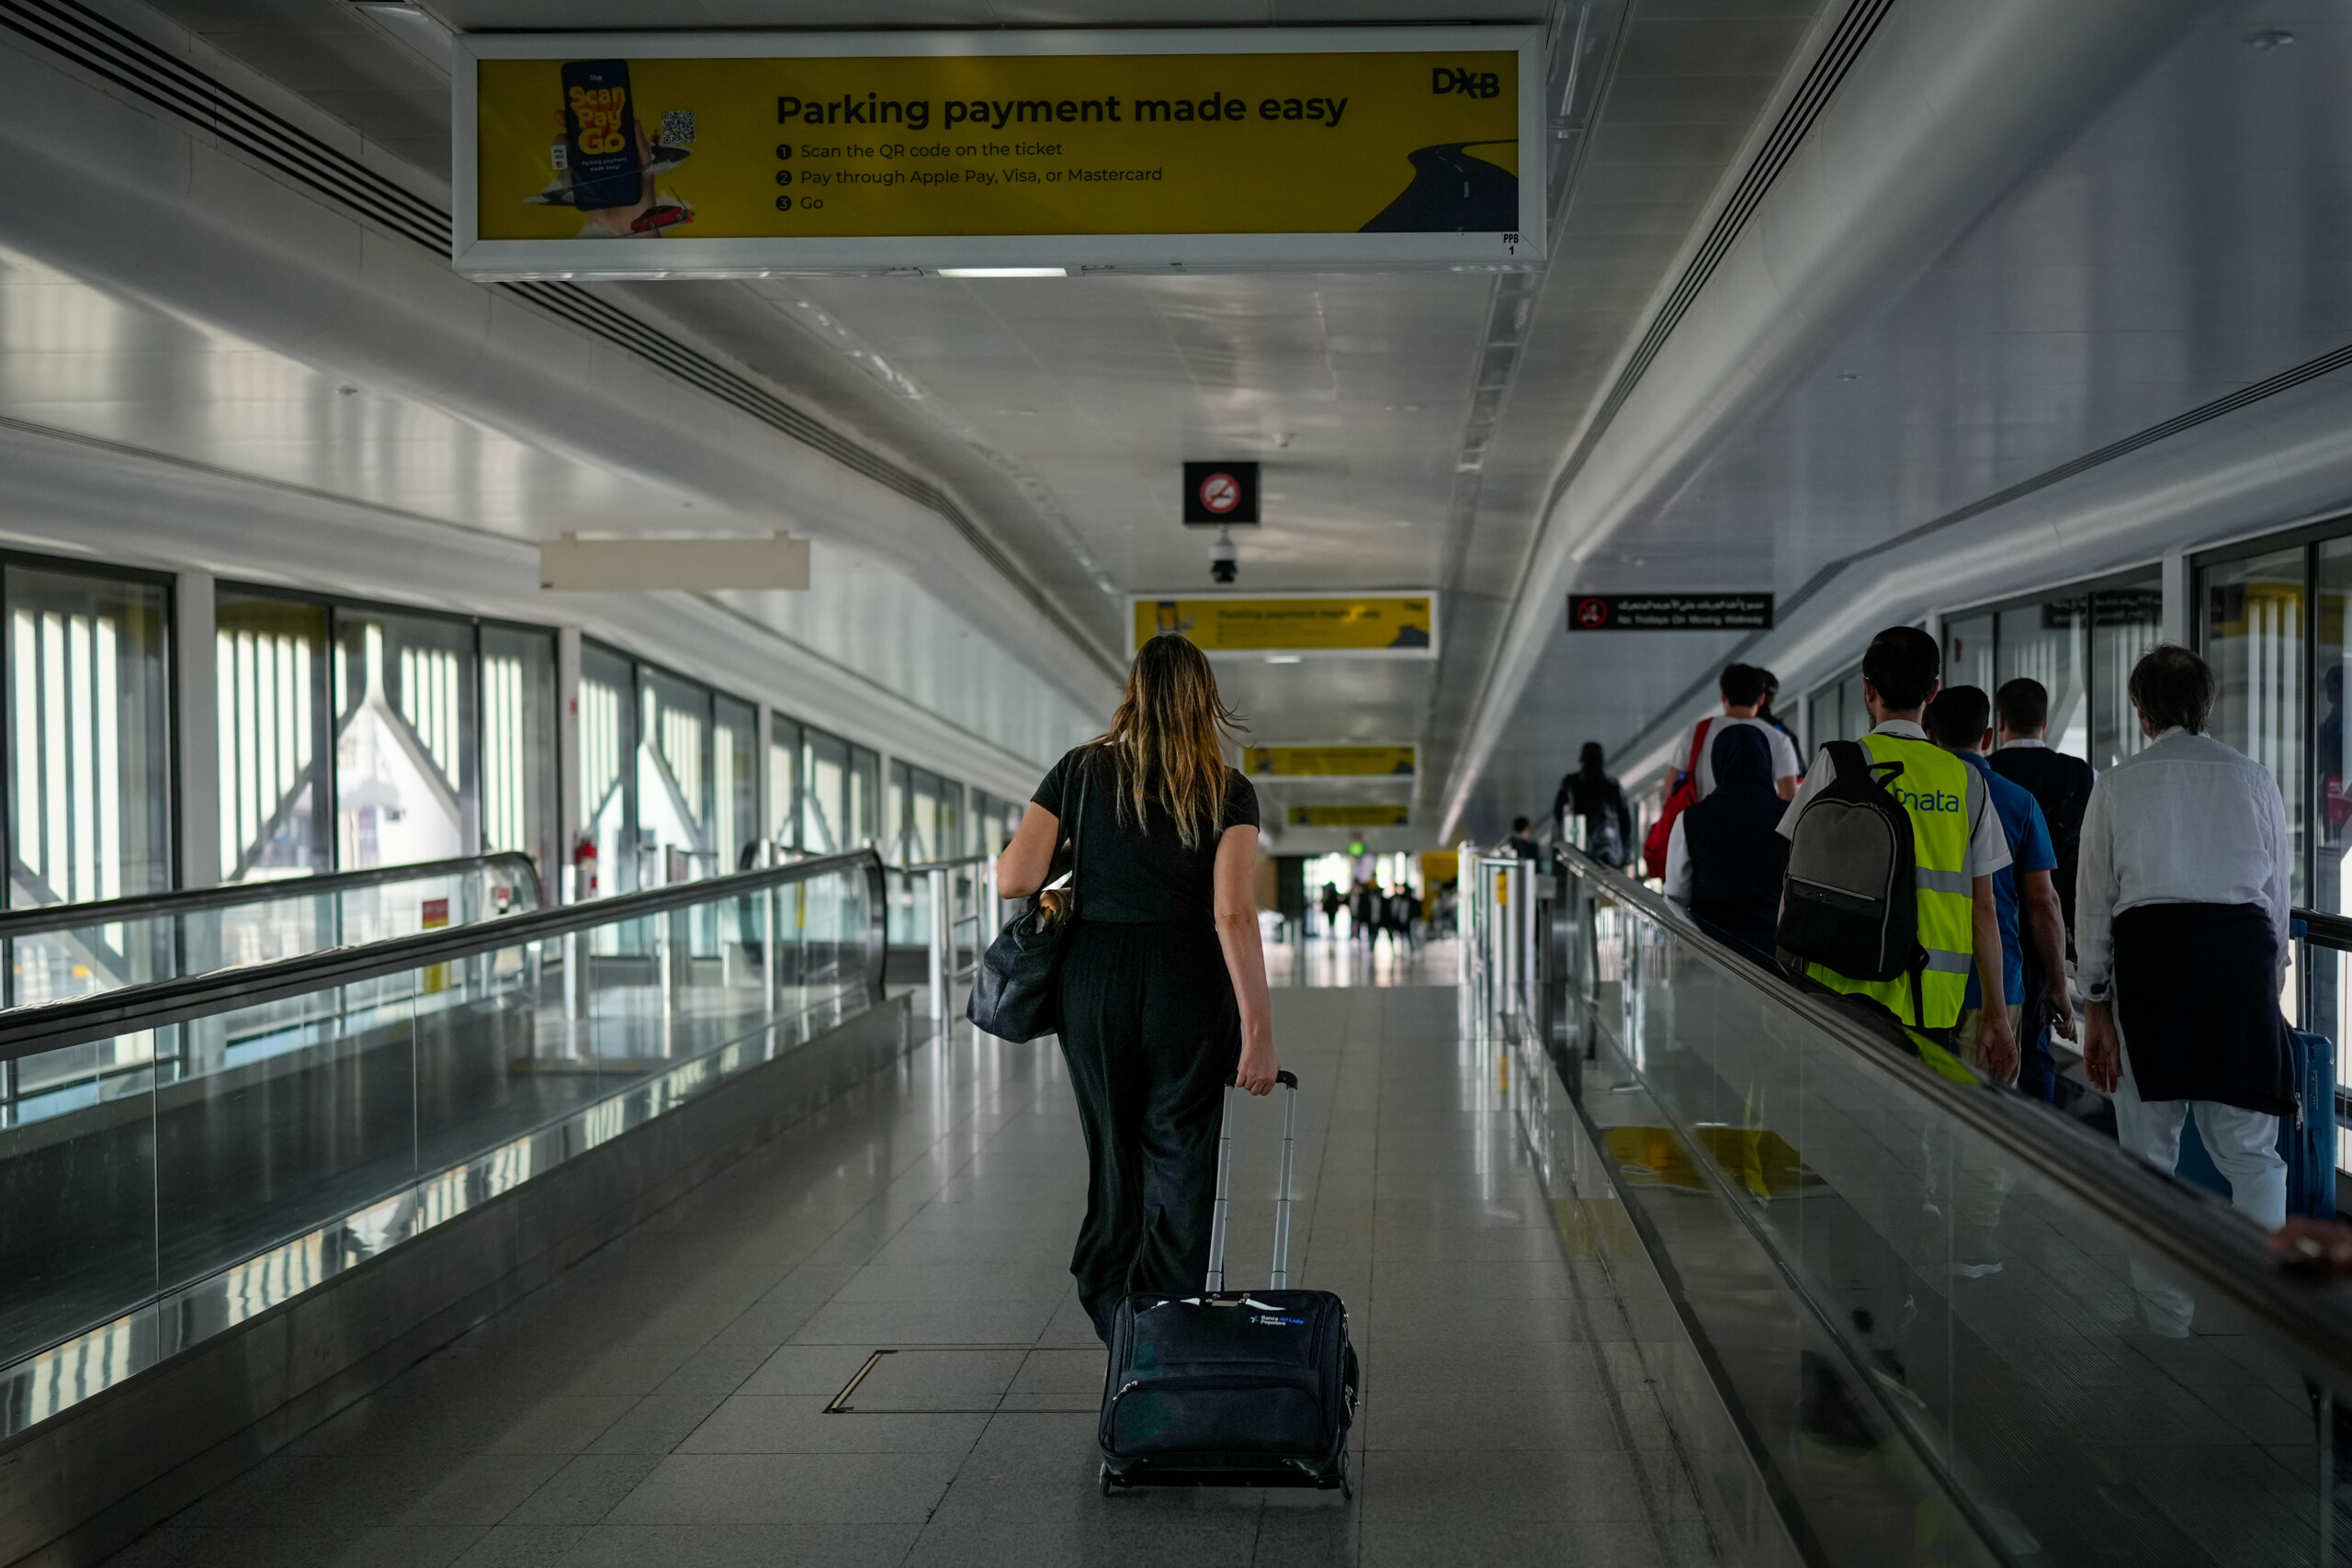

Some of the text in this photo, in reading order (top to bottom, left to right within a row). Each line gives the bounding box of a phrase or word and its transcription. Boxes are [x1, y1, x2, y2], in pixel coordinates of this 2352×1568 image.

[1431, 67, 1499, 99] DXB
[569, 85, 626, 111] Scan
[578, 107, 622, 132] Pay
[777, 92, 1349, 130] Parking payment made easy
[800, 144, 841, 158] Scan
[846, 143, 875, 158] the
[879, 143, 905, 160] QR
[910, 142, 951, 158] code
[956, 146, 977, 157] on
[982, 141, 1010, 156] the
[1015, 141, 1063, 156] ticket
[800, 171, 831, 186] Pay
[836, 171, 905, 186] through
[910, 169, 960, 186] Apple
[965, 170, 999, 186] Pay,
[1002, 168, 1041, 184] Visa,
[1046, 171, 1063, 183] or
[1069, 167, 1162, 182] Mastercard
[800, 197, 824, 209] Go
[1503, 233, 1519, 243] PPB
[1509, 245, 1514, 255] 1
